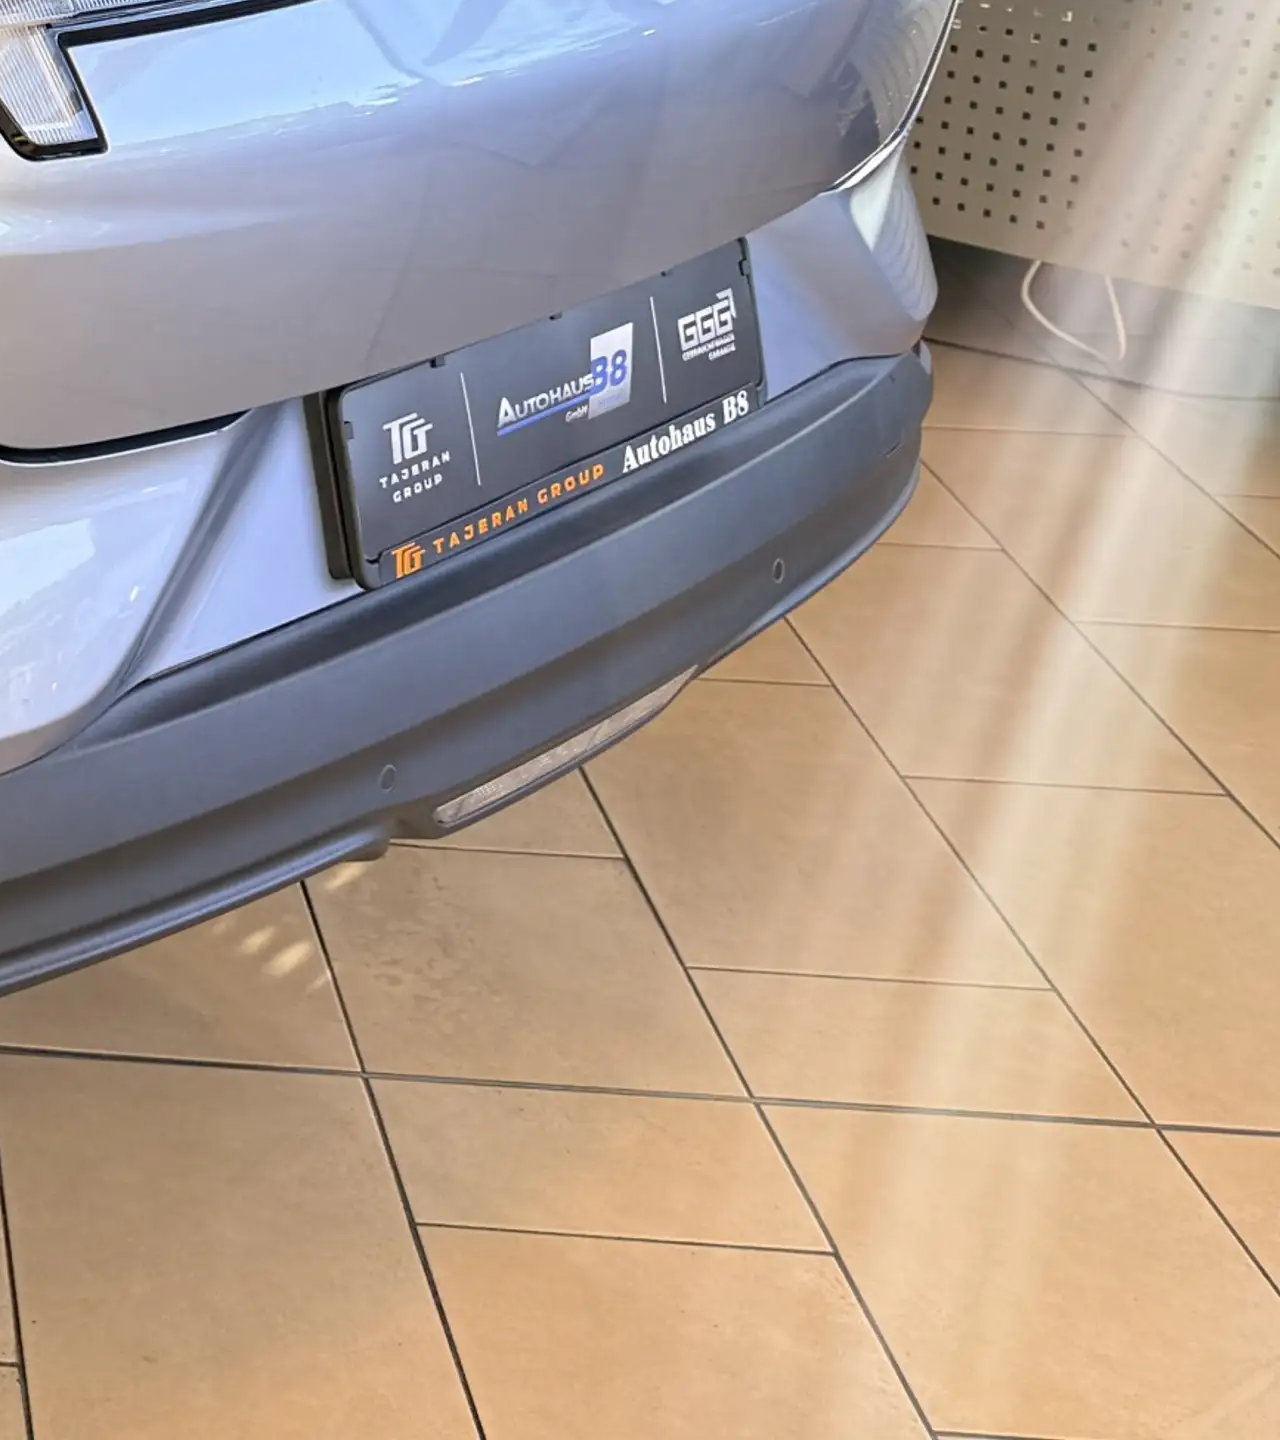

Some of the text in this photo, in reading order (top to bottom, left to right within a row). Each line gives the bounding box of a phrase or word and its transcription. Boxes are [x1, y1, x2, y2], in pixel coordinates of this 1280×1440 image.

[621, 389, 750, 474] Autohaus B8
[379, 449, 451, 489] TAJERAN
[392, 472, 443, 504] GROUP
[432, 497, 529, 555] TAJERAN
[536, 463, 605, 505] GROUP
